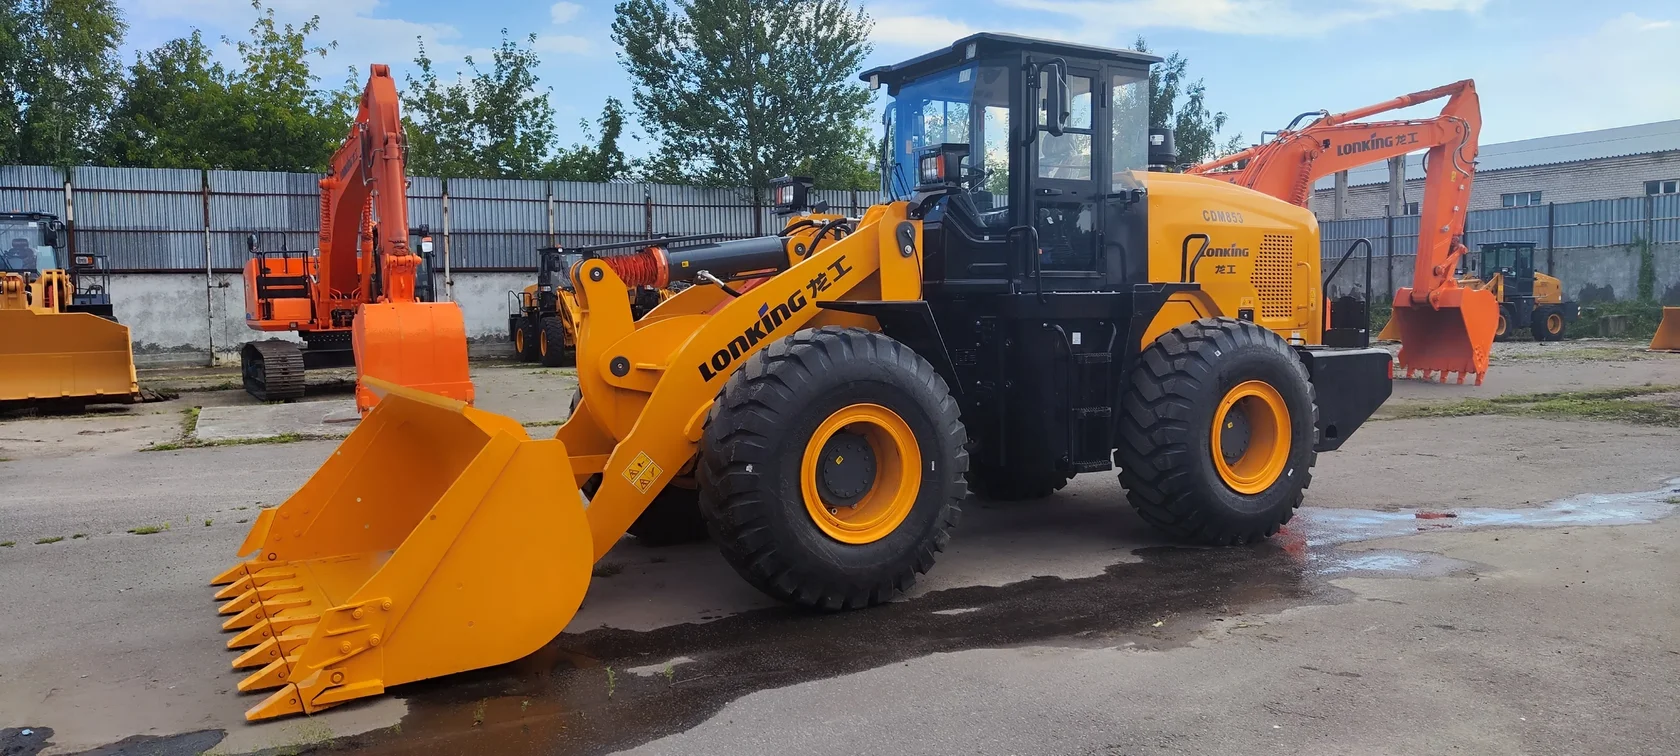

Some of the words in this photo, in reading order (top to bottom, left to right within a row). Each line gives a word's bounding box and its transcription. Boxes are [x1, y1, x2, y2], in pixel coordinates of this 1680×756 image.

[1395, 132, 1419, 146] 龙工
[1202, 209, 1244, 224] CDM853
[806, 255, 853, 298] 龙工
[1215, 264, 1237, 275] 龙工
